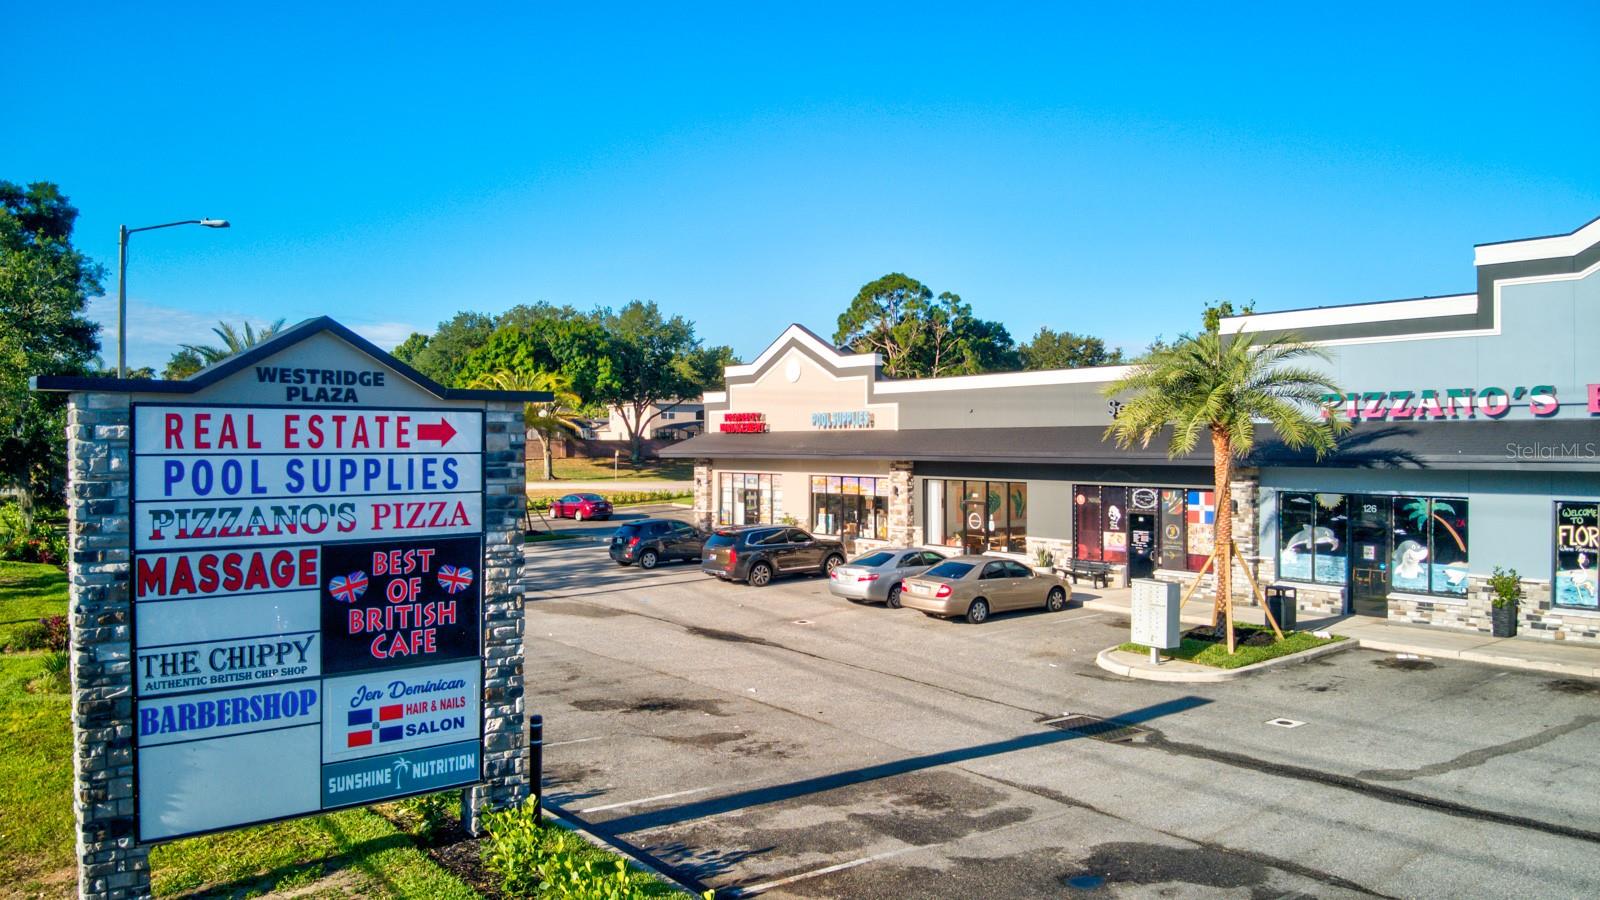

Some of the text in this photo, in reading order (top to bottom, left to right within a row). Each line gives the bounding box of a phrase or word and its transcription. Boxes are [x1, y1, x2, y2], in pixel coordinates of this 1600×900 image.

[256, 367, 385, 388] WESTRIDGE
[285, 386, 358, 403] PLAZA
[165, 413, 411, 450] REAL ESTATE
[164, 457, 459, 497] POOL SUPPLIES
[148, 501, 471, 541] PIZZANO'S PIZZA
[1363, 504, 1377, 513] 126
[1570, 517, 1584, 525] TO
[137, 549, 318, 597] MASSAGE
[372, 548, 435, 576] BEST
[386, 577, 422, 603] OF
[349, 601, 456, 635] BRITISH
[139, 634, 315, 679] THE CHIPPY
[370, 628, 437, 659] CAFE
[145, 666, 308, 692] AUTHENTIC BRITISH CHIP SHOP
[350, 678, 466, 708] Jen Dominican
[139, 689, 317, 737] BARBERSHOP
[406, 696, 466, 716] HAIR & NAILS
[405, 716, 465, 737] SALON
[329, 753, 475, 794] SUNSHINE NUTRITION
